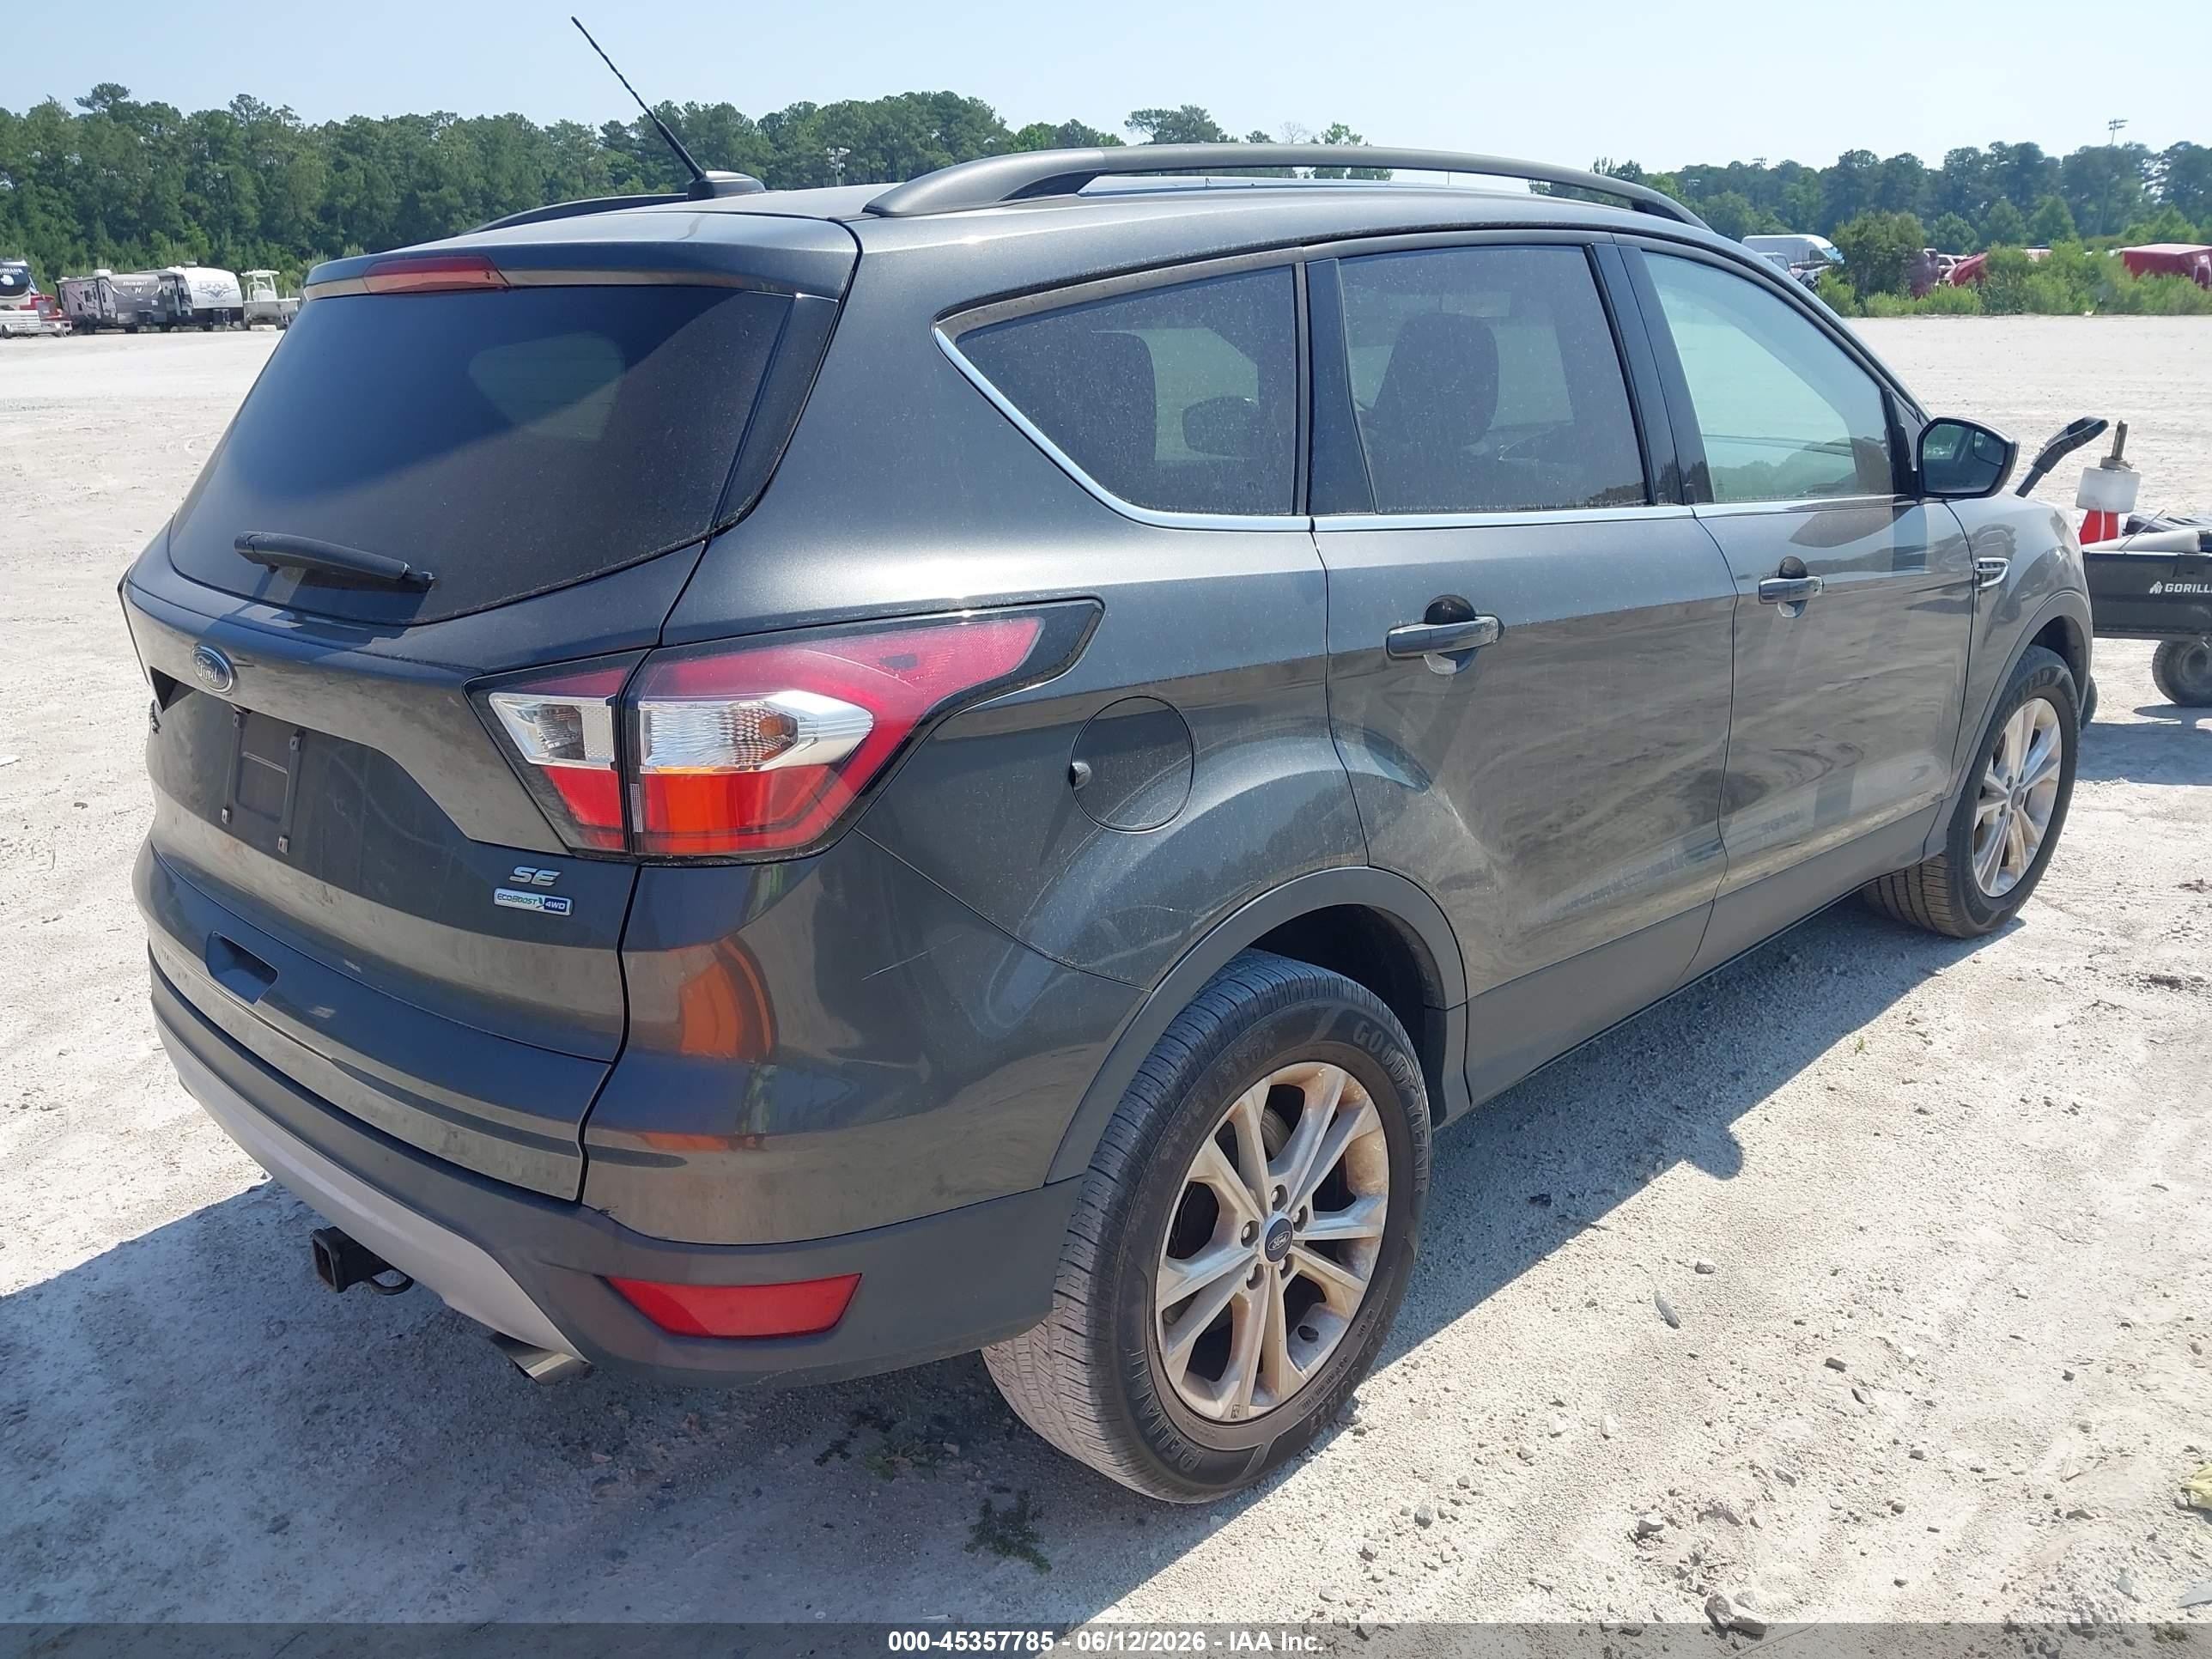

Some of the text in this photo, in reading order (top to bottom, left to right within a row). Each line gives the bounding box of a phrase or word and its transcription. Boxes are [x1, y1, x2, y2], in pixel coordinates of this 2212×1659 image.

[2165, 583, 2212, 593] GORILL
[509, 866, 562, 886] SE
[545, 900, 566, 909] 4WD
